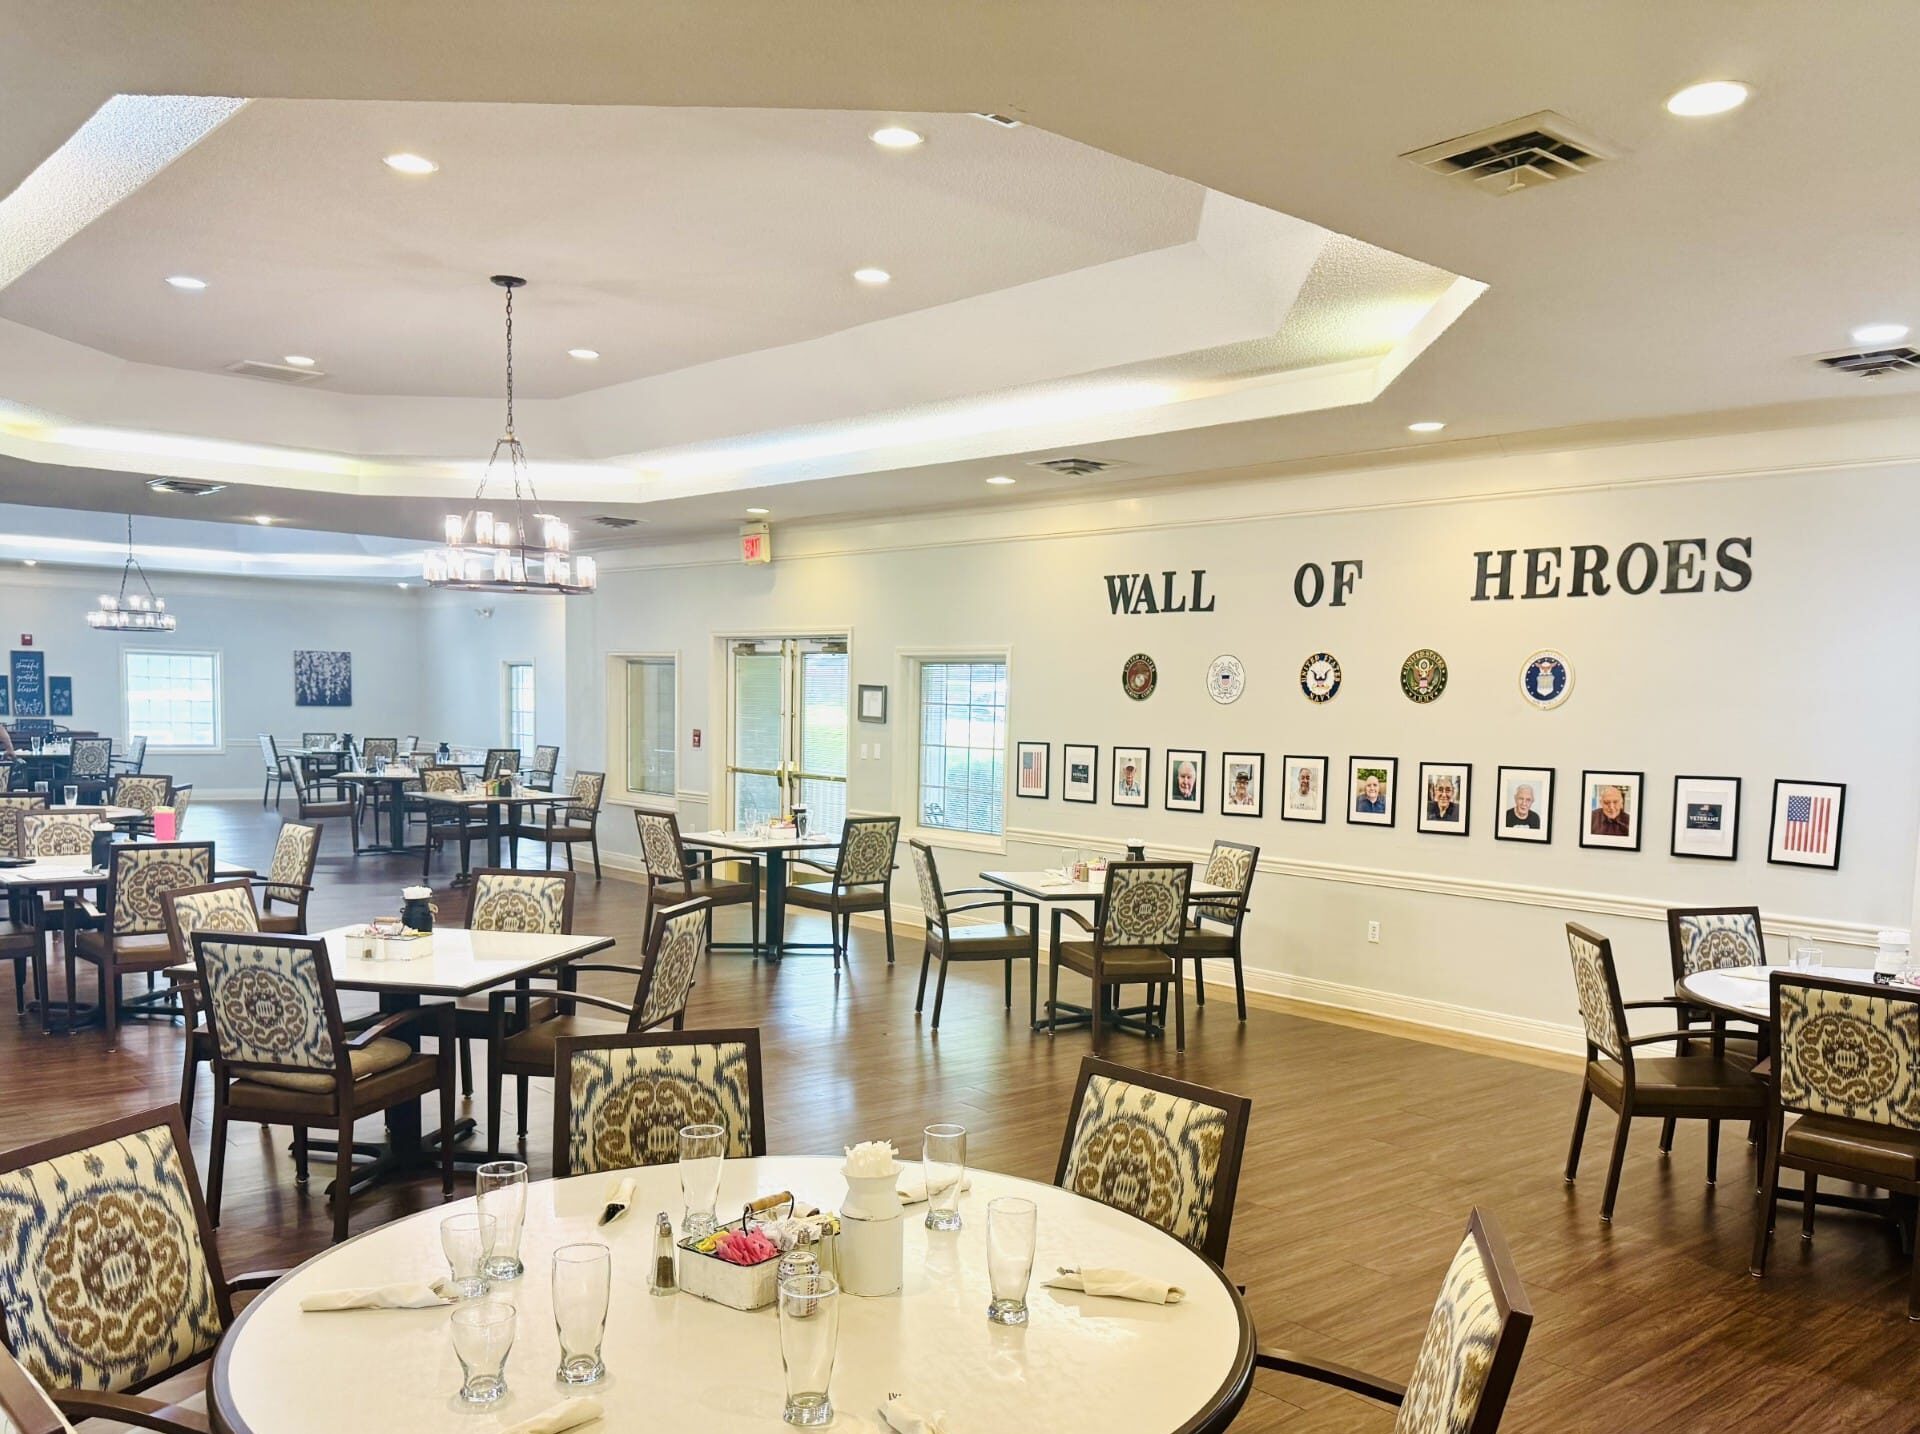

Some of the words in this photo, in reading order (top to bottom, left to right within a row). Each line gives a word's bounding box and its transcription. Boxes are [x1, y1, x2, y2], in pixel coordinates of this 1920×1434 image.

[1104, 570, 1215, 615] WALL
[1294, 560, 1363, 607] OF
[1470, 537, 1752, 601] HEROES
[1301, 655, 1319, 682] UNITED
[1324, 655, 1341, 682] STATES
[1310, 691, 1330, 702] NAVY
[1412, 694, 1434, 702] ARMY
